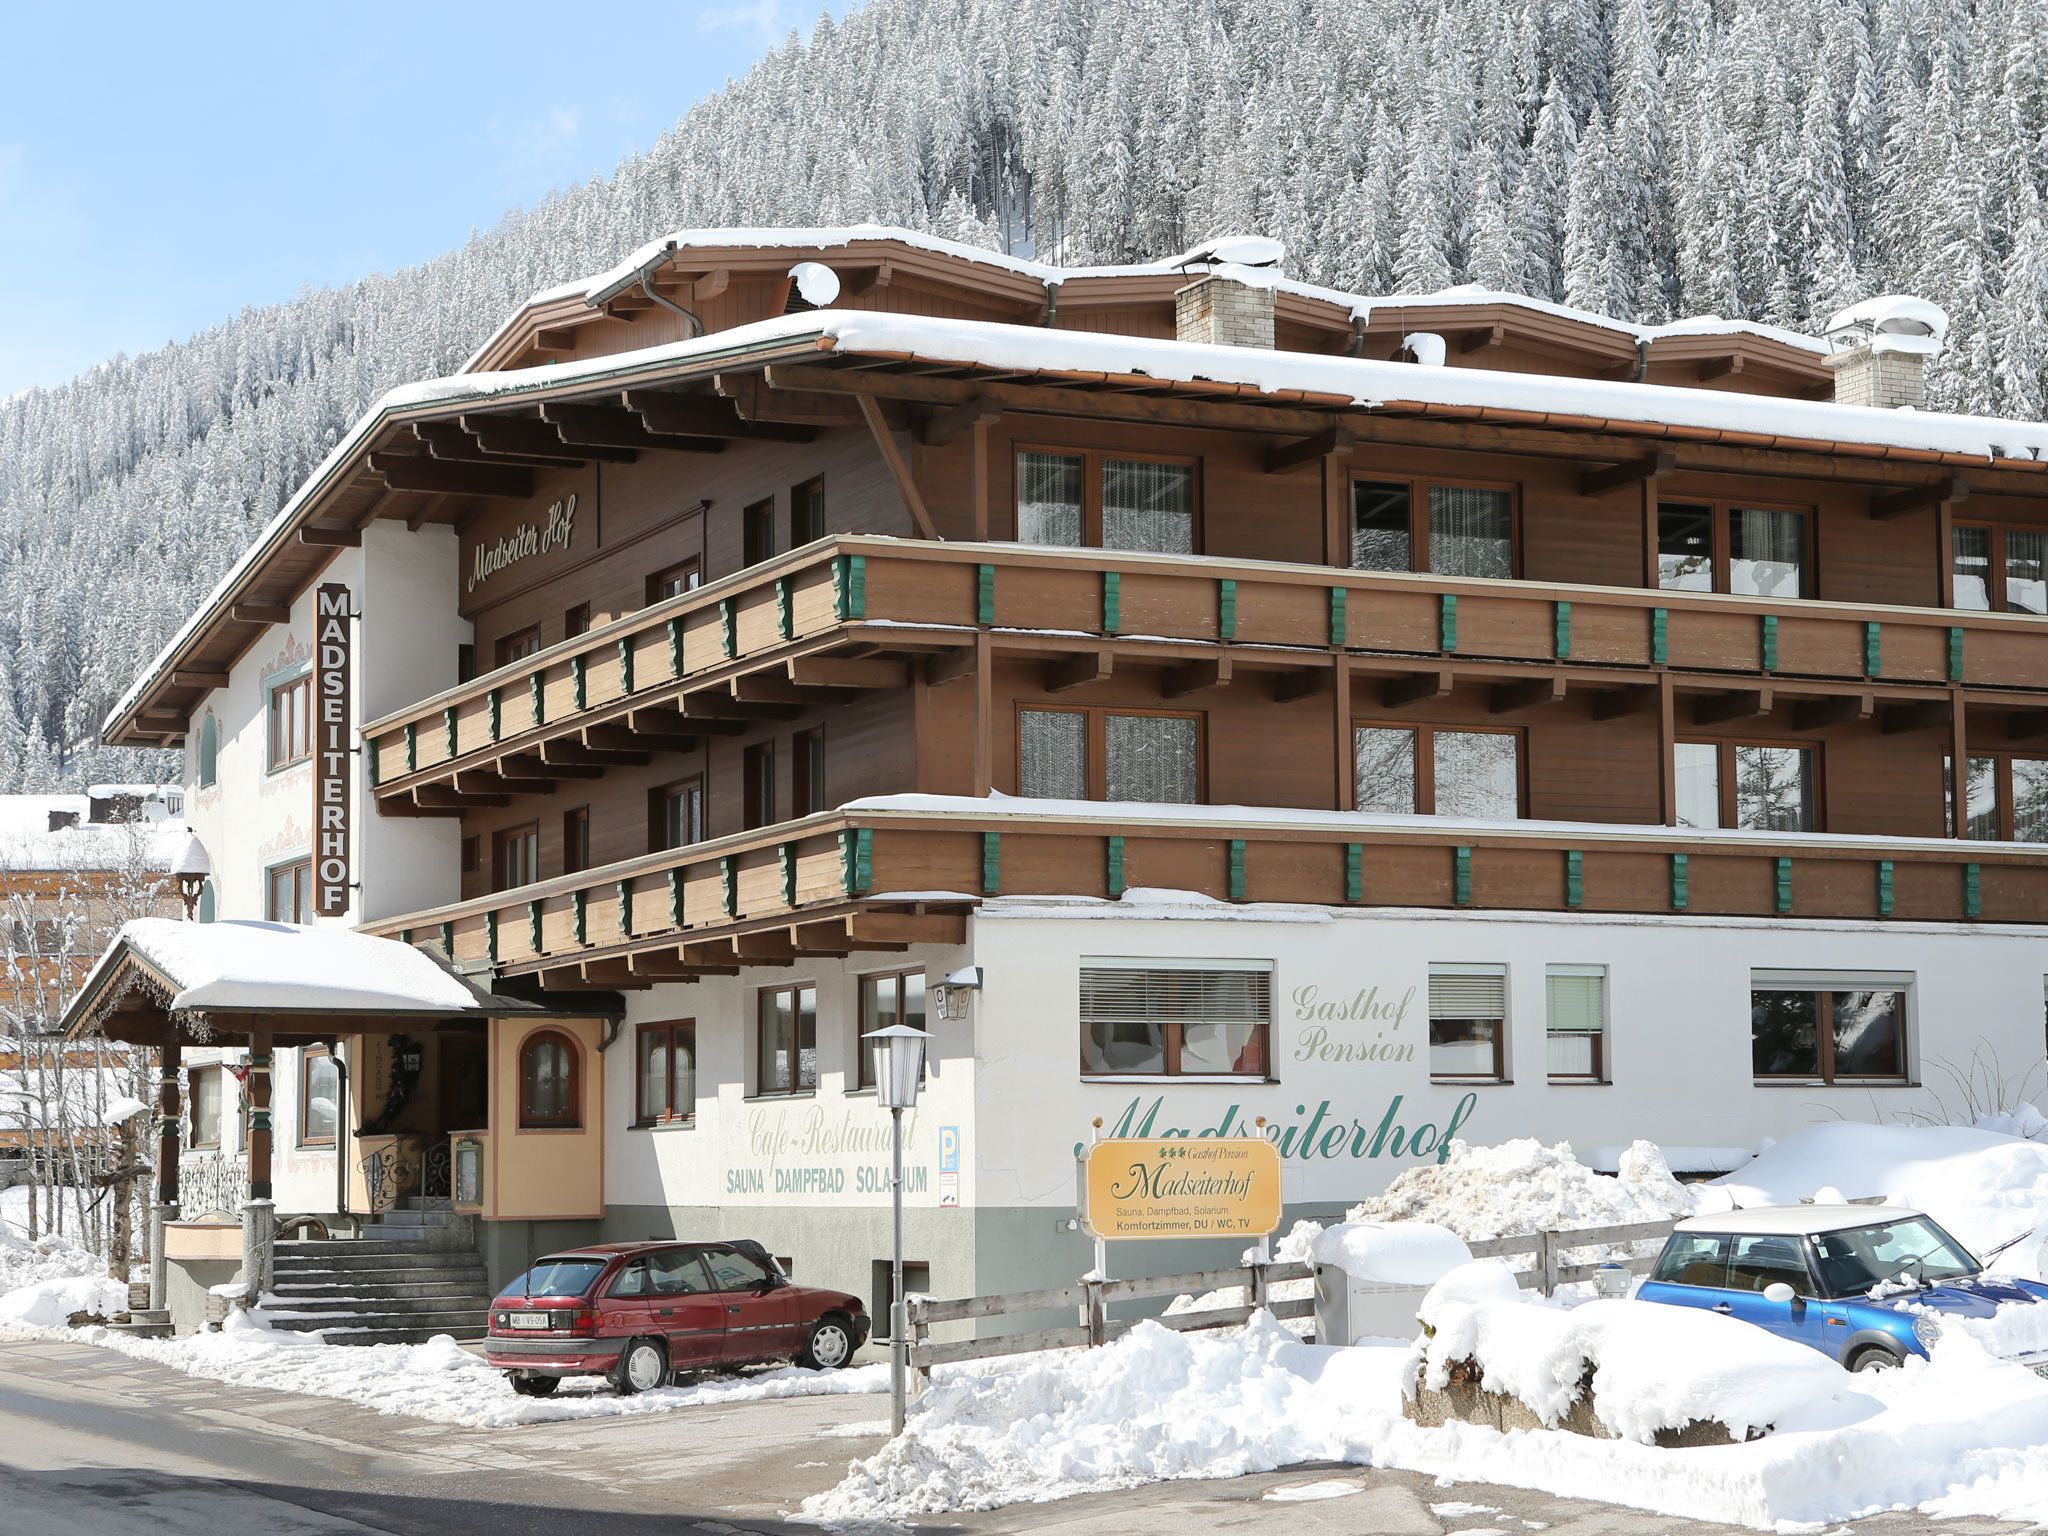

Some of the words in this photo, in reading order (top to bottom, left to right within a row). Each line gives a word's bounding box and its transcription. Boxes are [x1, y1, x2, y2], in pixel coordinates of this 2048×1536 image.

[469, 523, 539, 593] Madseiter
[542, 494, 577, 554] Hof
[318, 591, 349, 911] MADSEITERHOF
[1292, 984, 1417, 1031] Gasthof
[1295, 1026, 1416, 1063] Pension
[941, 1130, 957, 1169] P
[1187, 1147, 1219, 1162] Gasthof
[1219, 1147, 1249, 1160] Pension
[726, 1168, 764, 1194] SAUNA
[775, 1167, 845, 1194] DAMPFBAD
[856, 1166, 927, 1193] SOLAIUM
[1111, 1162, 1255, 1201] Madseiterhof
[1116, 1207, 1145, 1217] Sauna,
[1147, 1206, 1192, 1217] Dampfbad,
[1193, 1205, 1229, 1215] Solarium
[1116, 1220, 1192, 1231] Komfortzimmer,
[1194, 1219, 1208, 1229] DU
[1216, 1218, 1236, 1229] WC,
[1238, 1218, 1250, 1228] TV
